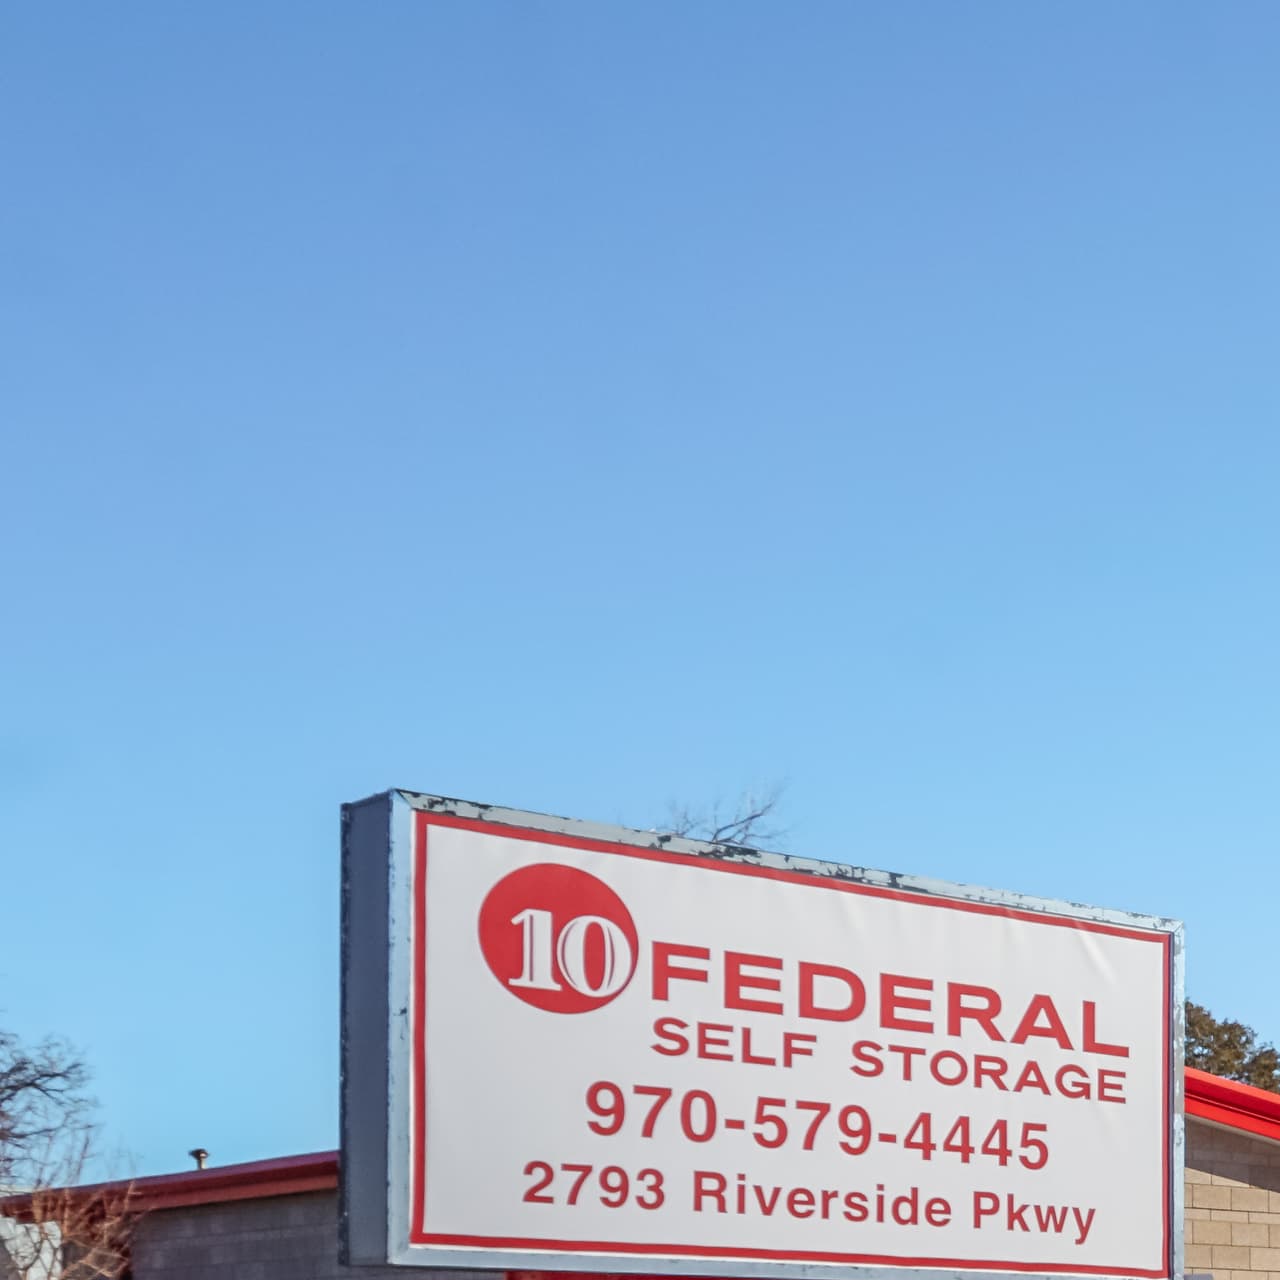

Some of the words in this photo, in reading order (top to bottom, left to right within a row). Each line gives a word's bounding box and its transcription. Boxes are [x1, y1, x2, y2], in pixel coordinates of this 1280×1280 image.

[508, 908, 632, 1000] 10
[652, 942, 1130, 1058] FEDERAL
[652, 1018, 817, 1068] SELF
[851, 1041, 1127, 1104] STORAGE
[586, 1082, 1050, 1171] 970-579-4445
[523, 1162, 666, 1210] 2793
[693, 1170, 953, 1229] Riverside
[973, 1191, 1096, 1246] Pkwy
